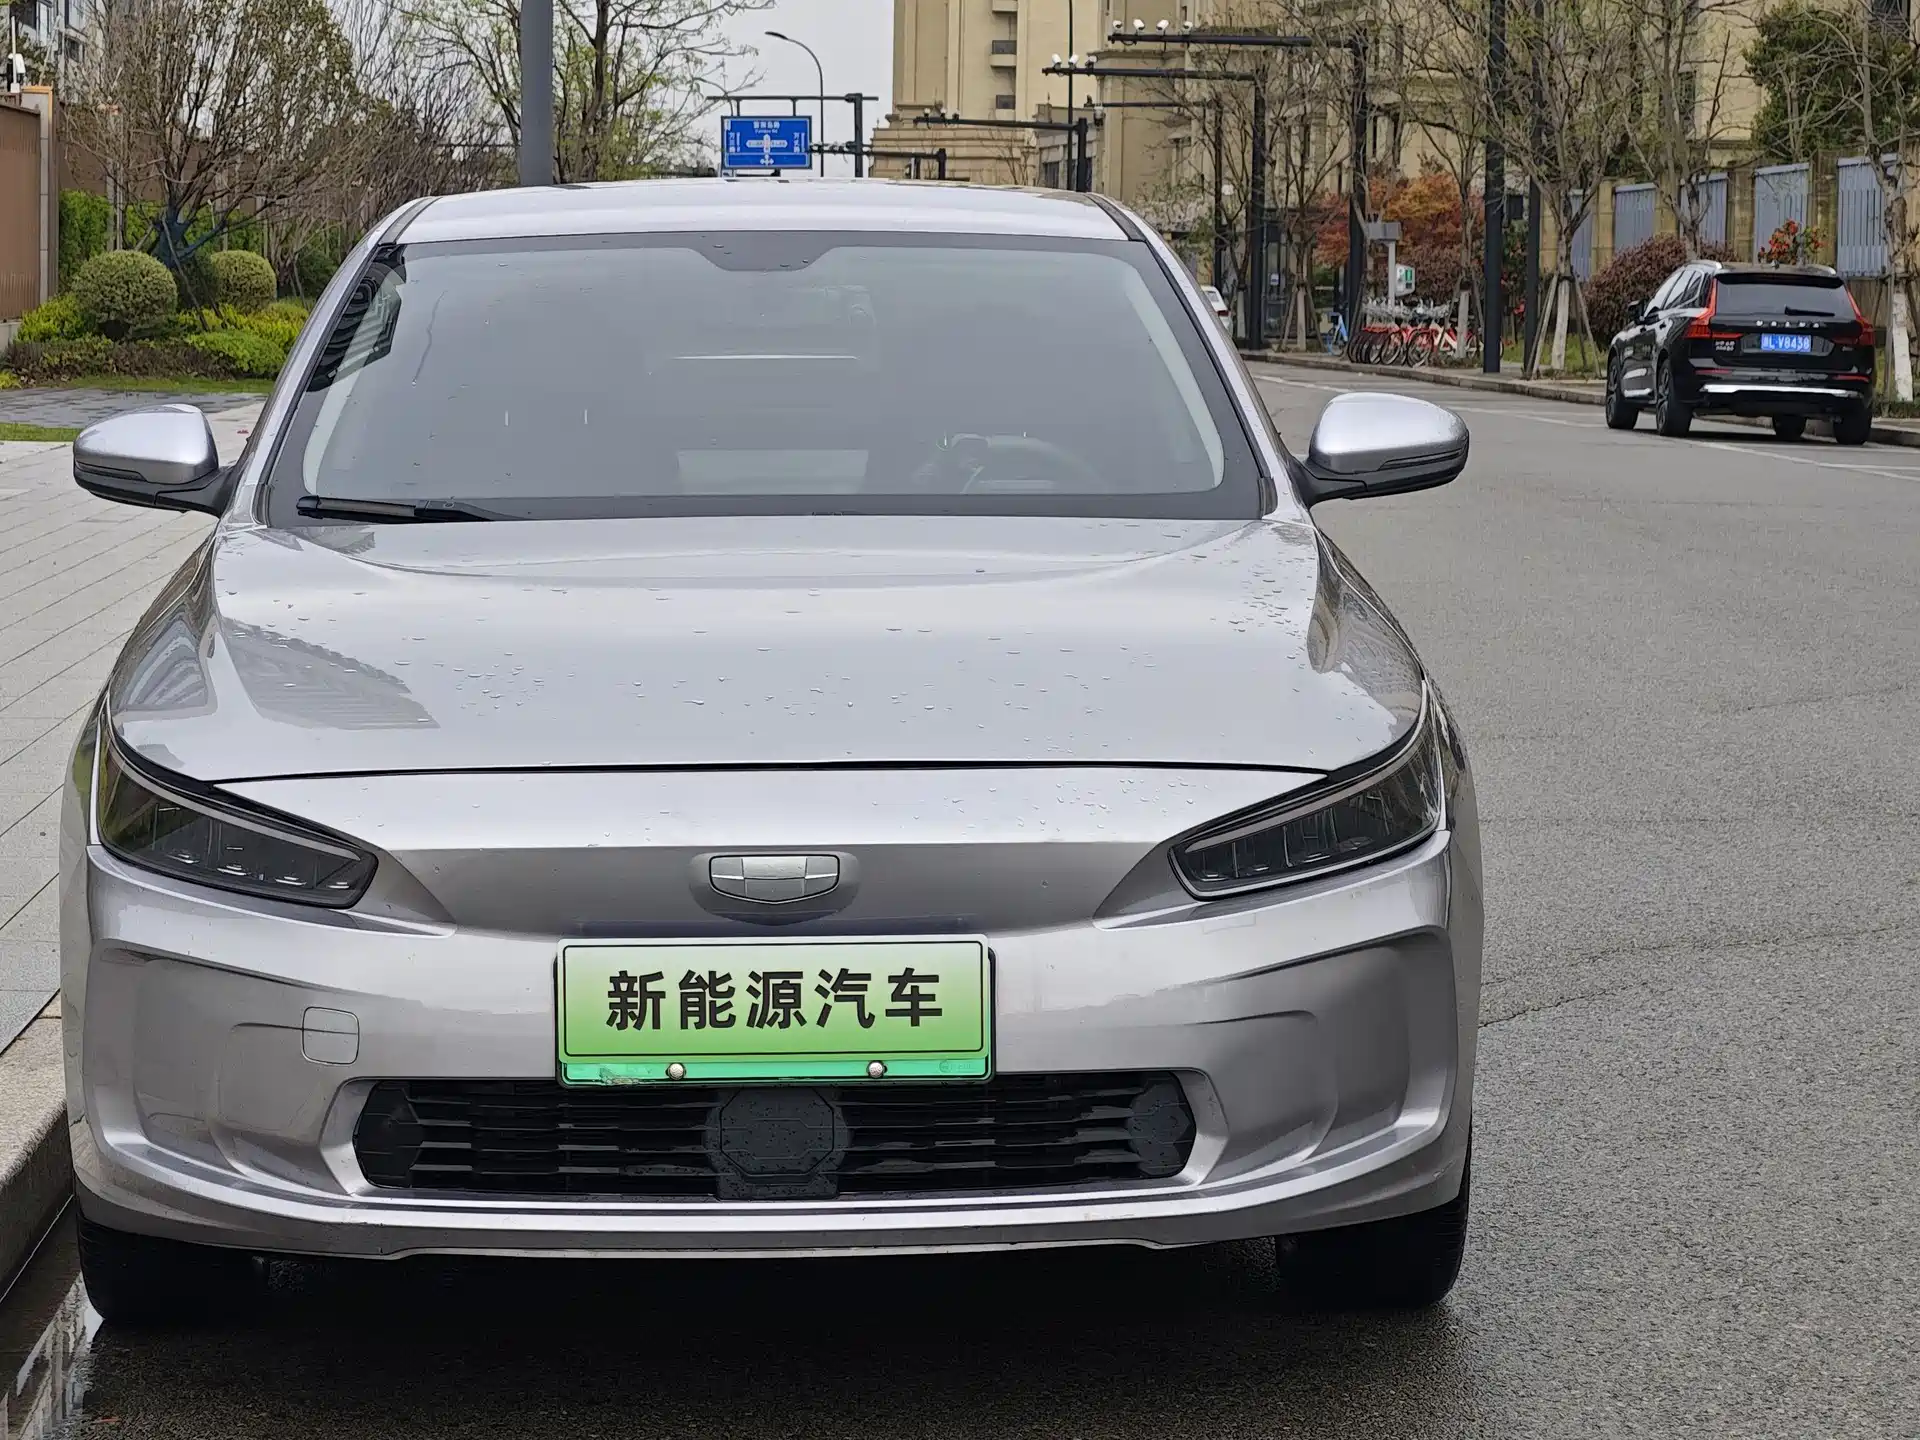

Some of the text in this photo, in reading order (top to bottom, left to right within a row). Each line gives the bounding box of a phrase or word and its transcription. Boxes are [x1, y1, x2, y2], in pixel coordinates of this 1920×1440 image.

[606, 968, 942, 1030] 新能源汽车
